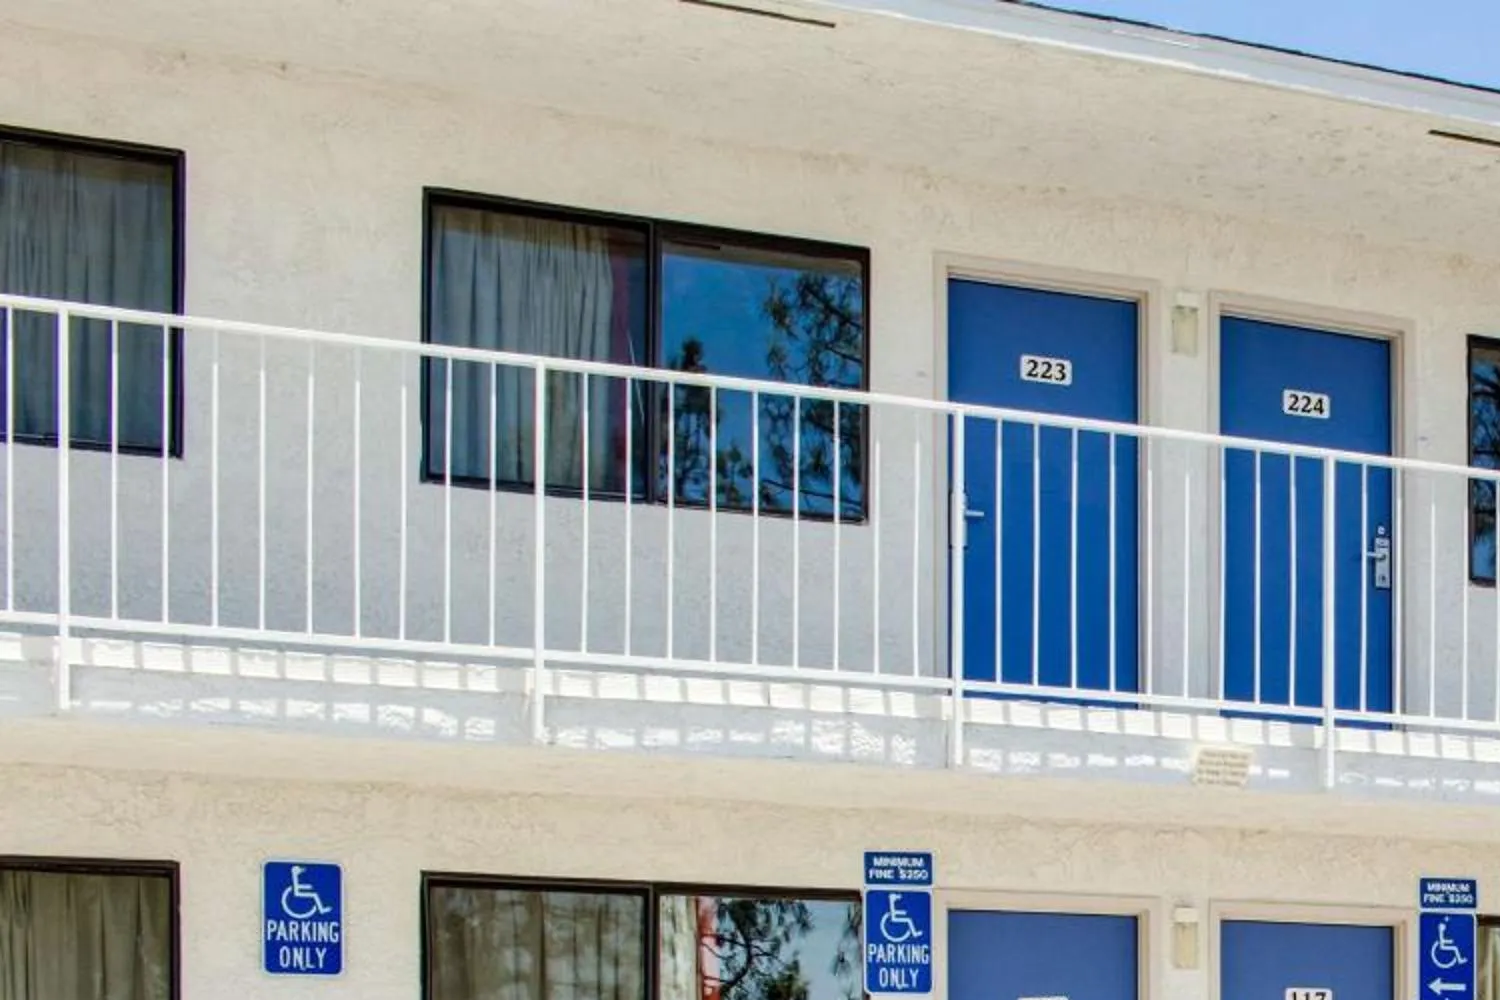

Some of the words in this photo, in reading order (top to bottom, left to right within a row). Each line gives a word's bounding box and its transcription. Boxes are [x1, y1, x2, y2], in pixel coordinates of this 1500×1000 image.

[1026, 359, 1067, 382] 223
[1287, 393, 1325, 415] 224
[873, 857, 924, 867] MINIMUM
[868, 869, 895, 880] FINE
[899, 869, 929, 880] $250
[1423, 893, 1444, 903] FINE
[267, 920, 339, 943] PARKING
[280, 946, 327, 969] ONLY
[868, 943, 929, 965] PARKING
[879, 967, 919, 989] ONLY
